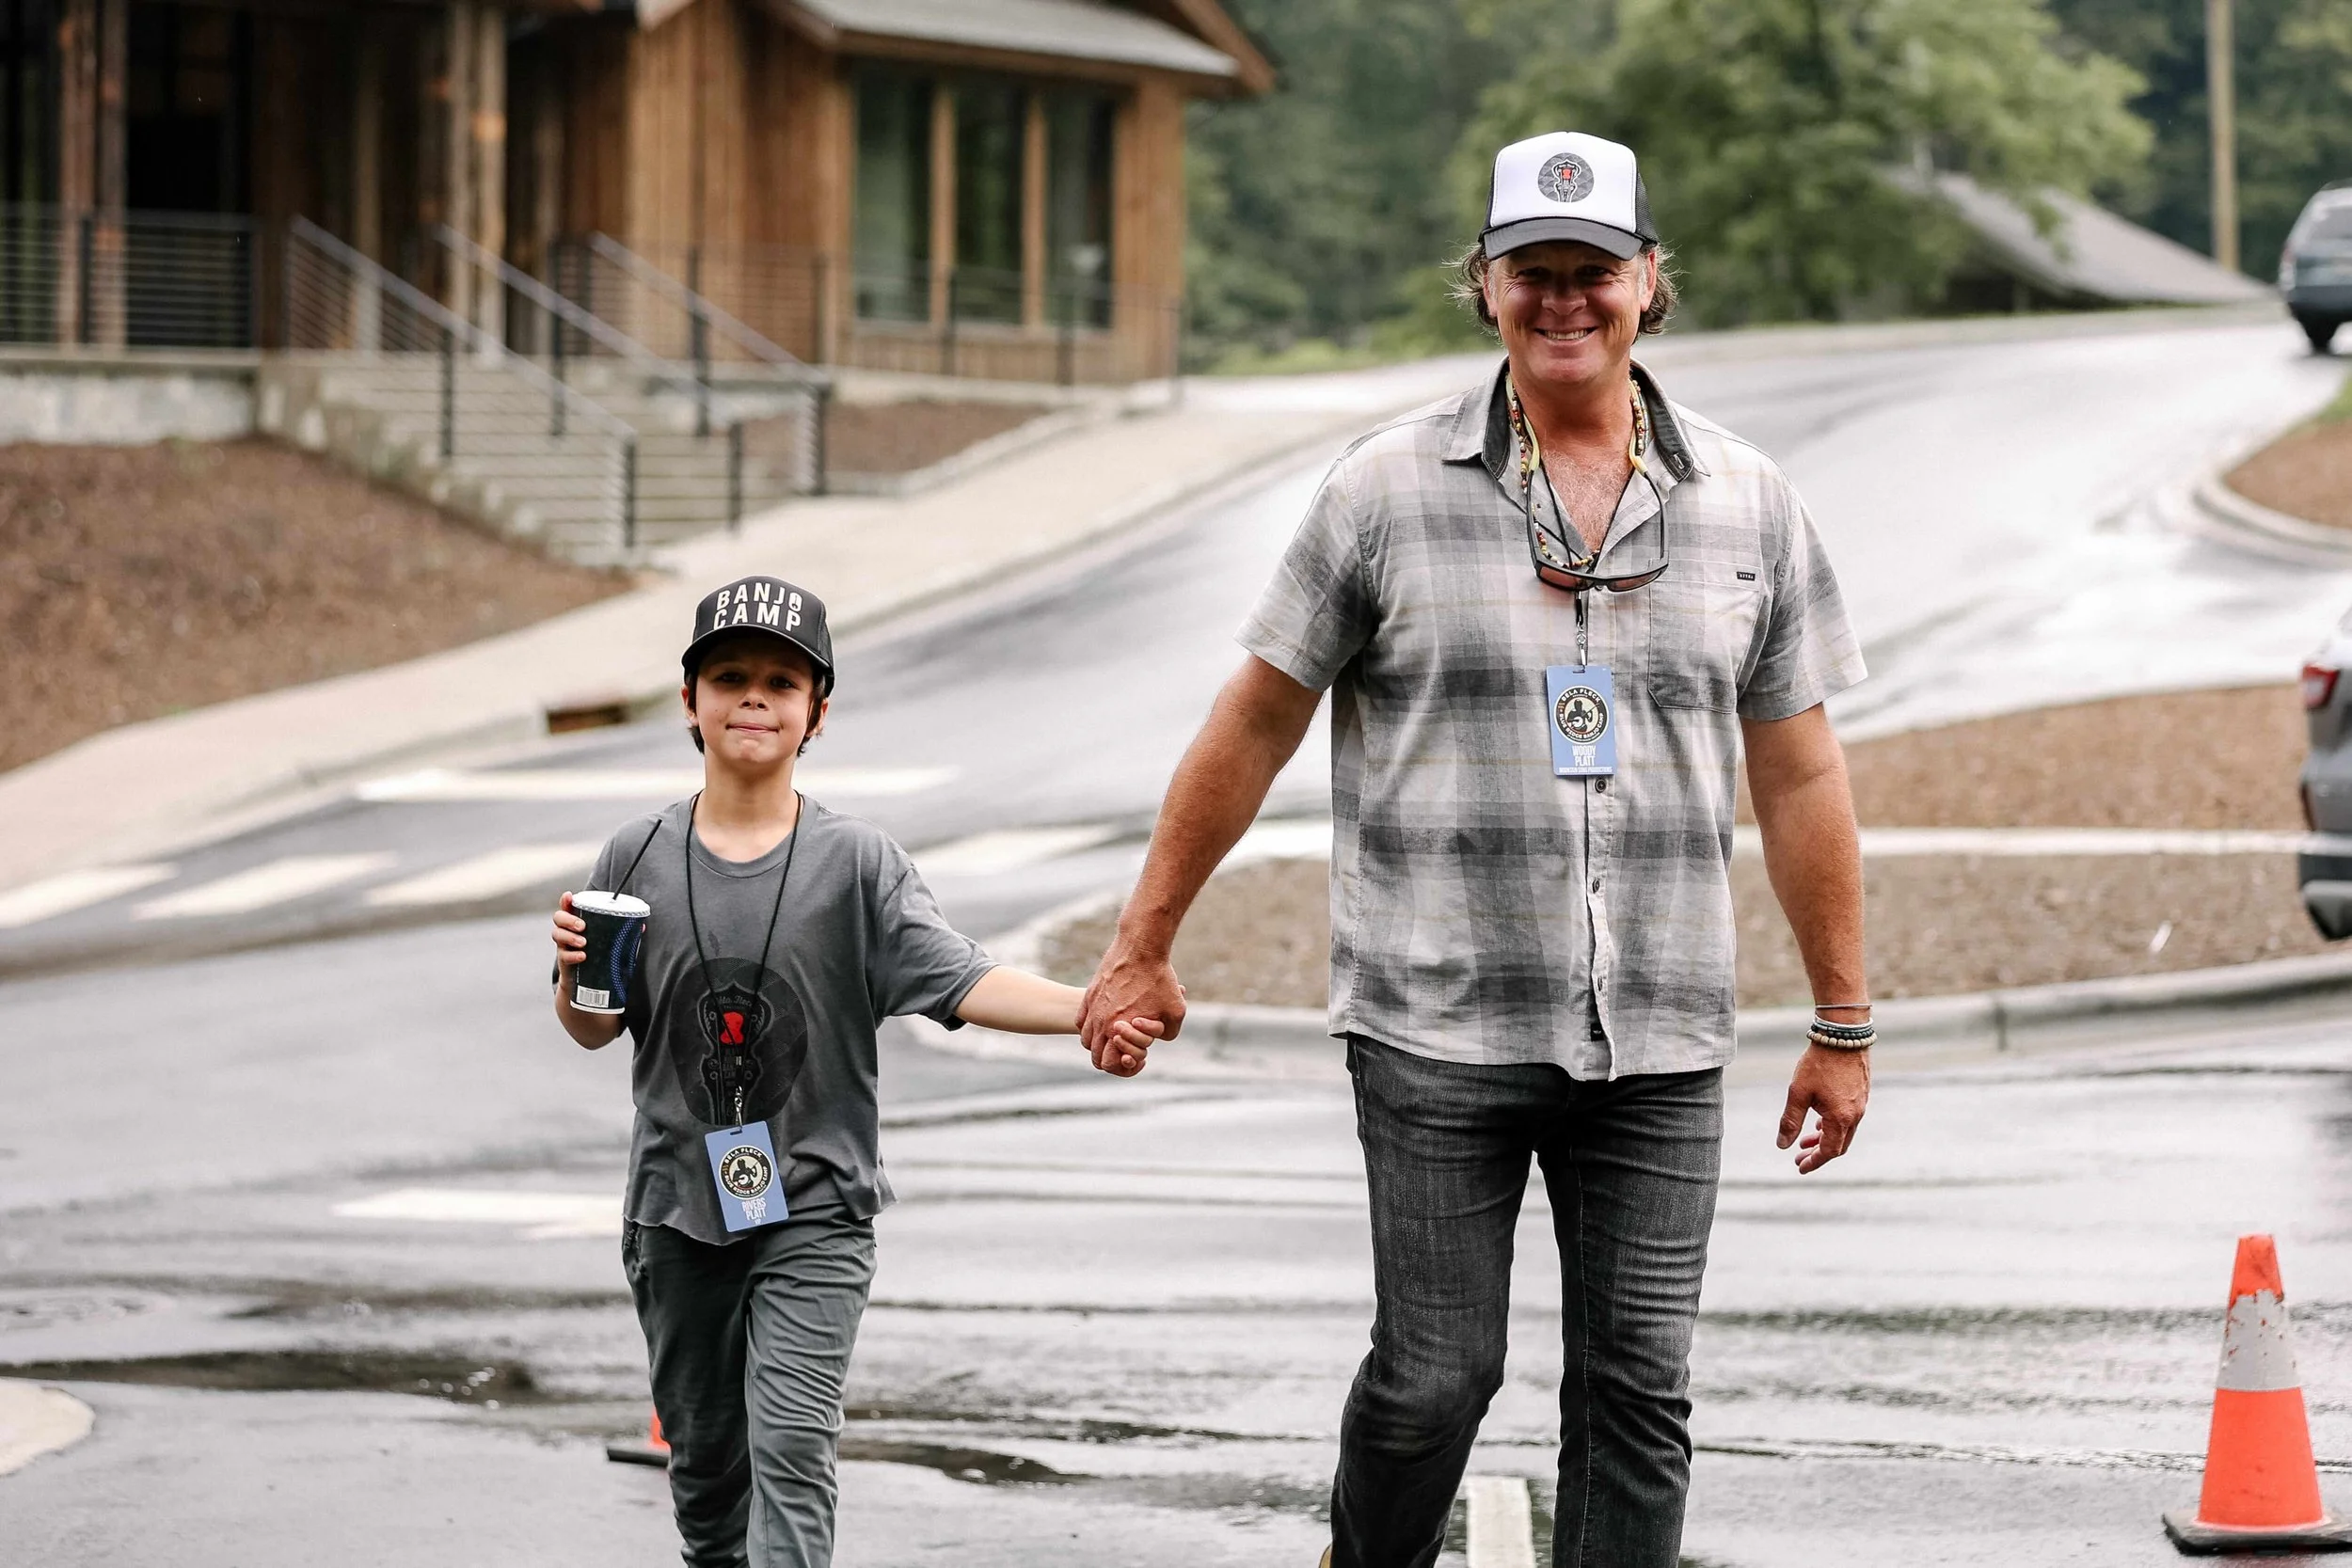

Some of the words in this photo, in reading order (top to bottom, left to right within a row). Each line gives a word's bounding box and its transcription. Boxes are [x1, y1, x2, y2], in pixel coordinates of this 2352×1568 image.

[717, 582, 803, 611] BANJO
[713, 602, 802, 632] CAMP
[1580, 689, 1601, 703] FLECK
[1575, 755, 1596, 767] PLATT
[740, 1148, 763, 1158] FLECK
[741, 1197, 767, 1212] RIVERS
[746, 1207, 766, 1221] PLATT
